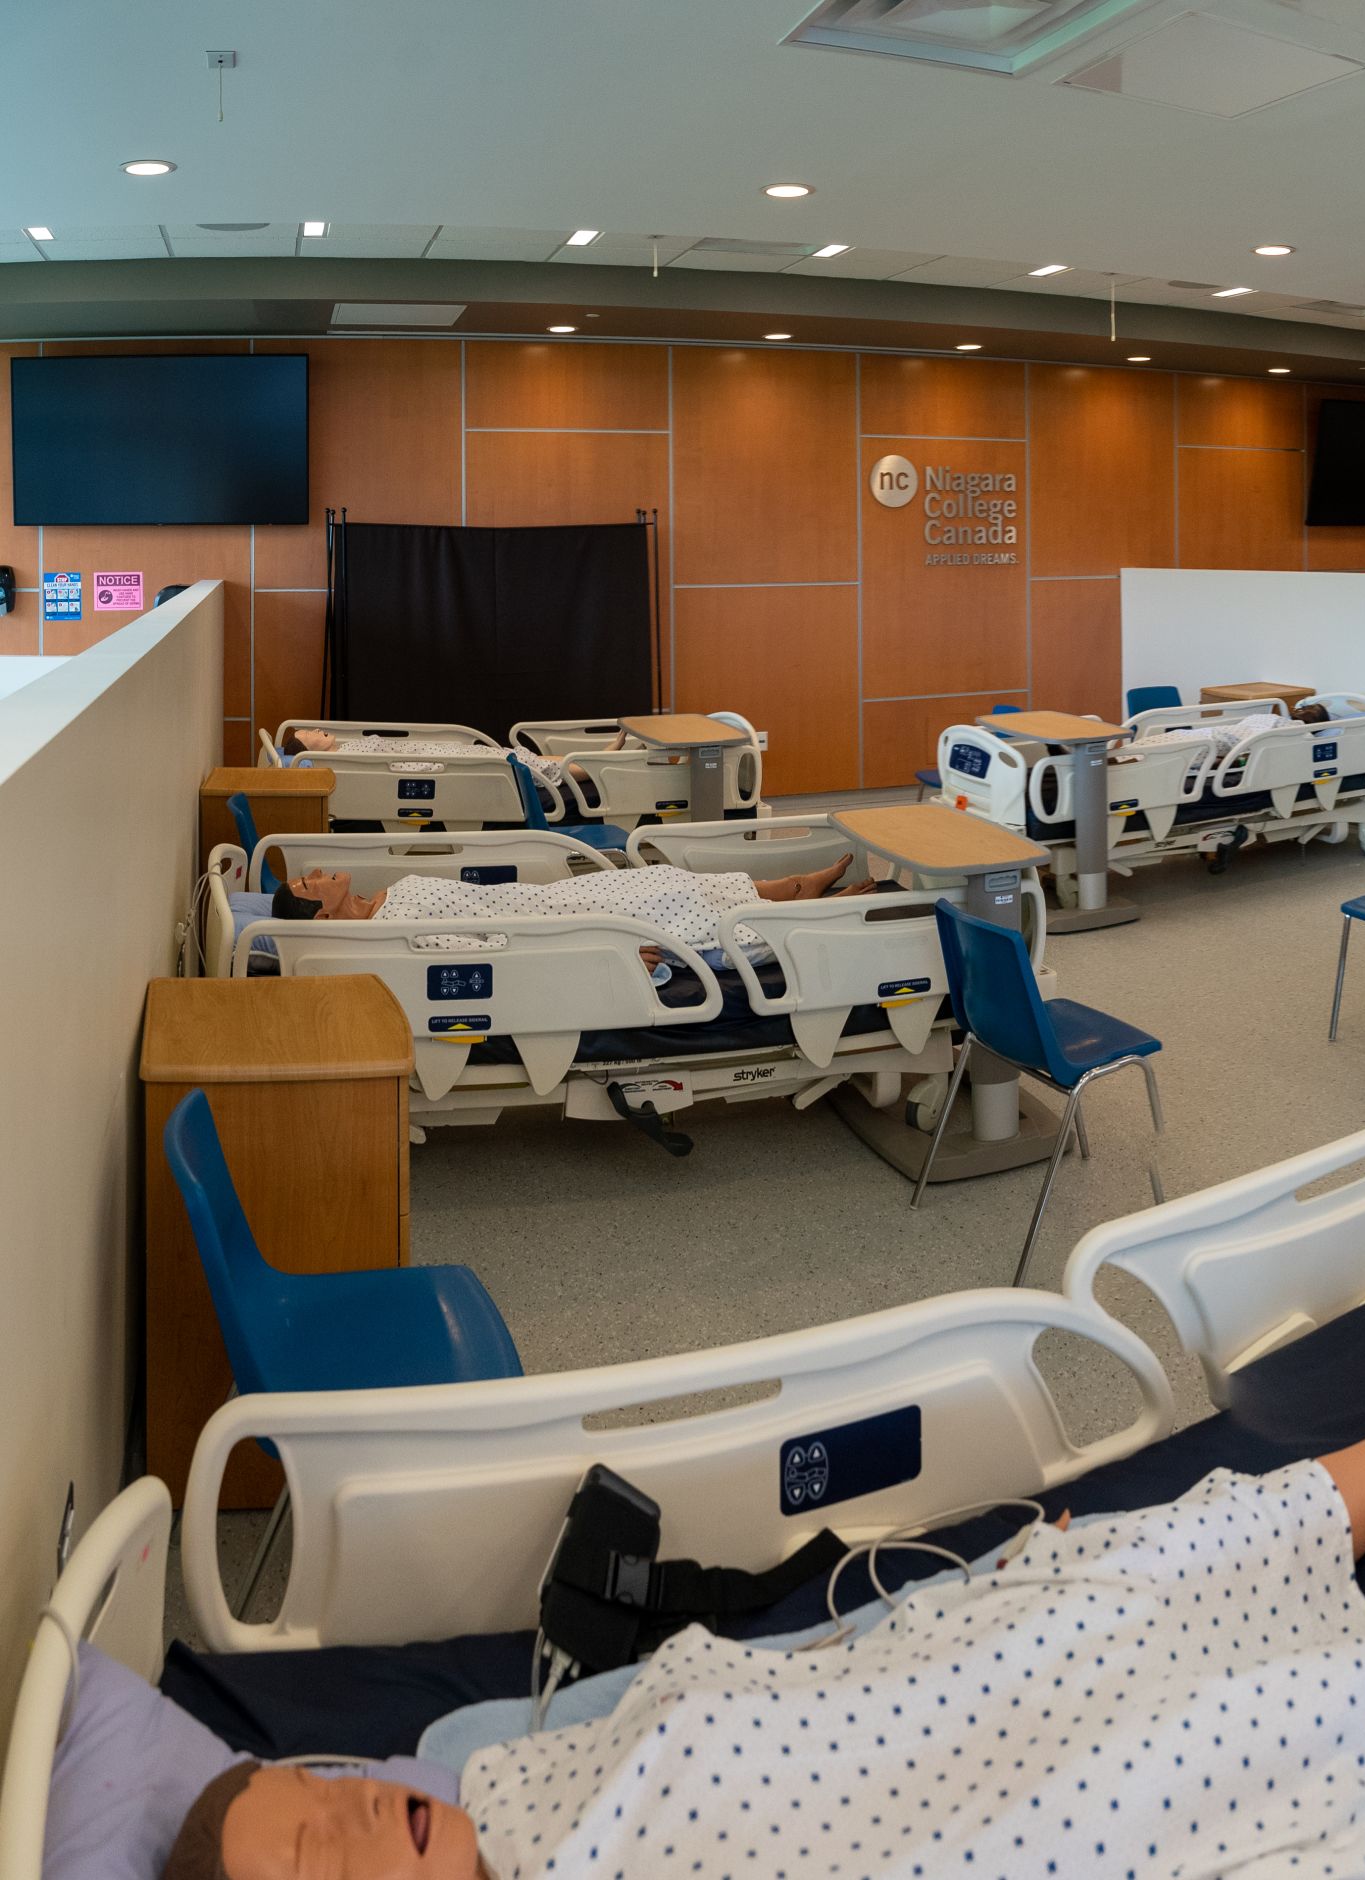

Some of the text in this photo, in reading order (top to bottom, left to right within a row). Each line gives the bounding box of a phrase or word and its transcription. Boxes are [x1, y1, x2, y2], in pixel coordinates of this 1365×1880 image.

[879, 471, 909, 491] nc
[924, 465, 1017, 497] Niagara
[924, 492, 1017, 524] College
[924, 519, 1017, 545] Canada
[925, 553, 970, 566] APPLIED
[99, 576, 138, 585] NOTICE
[732, 1067, 775, 1082] stryker
